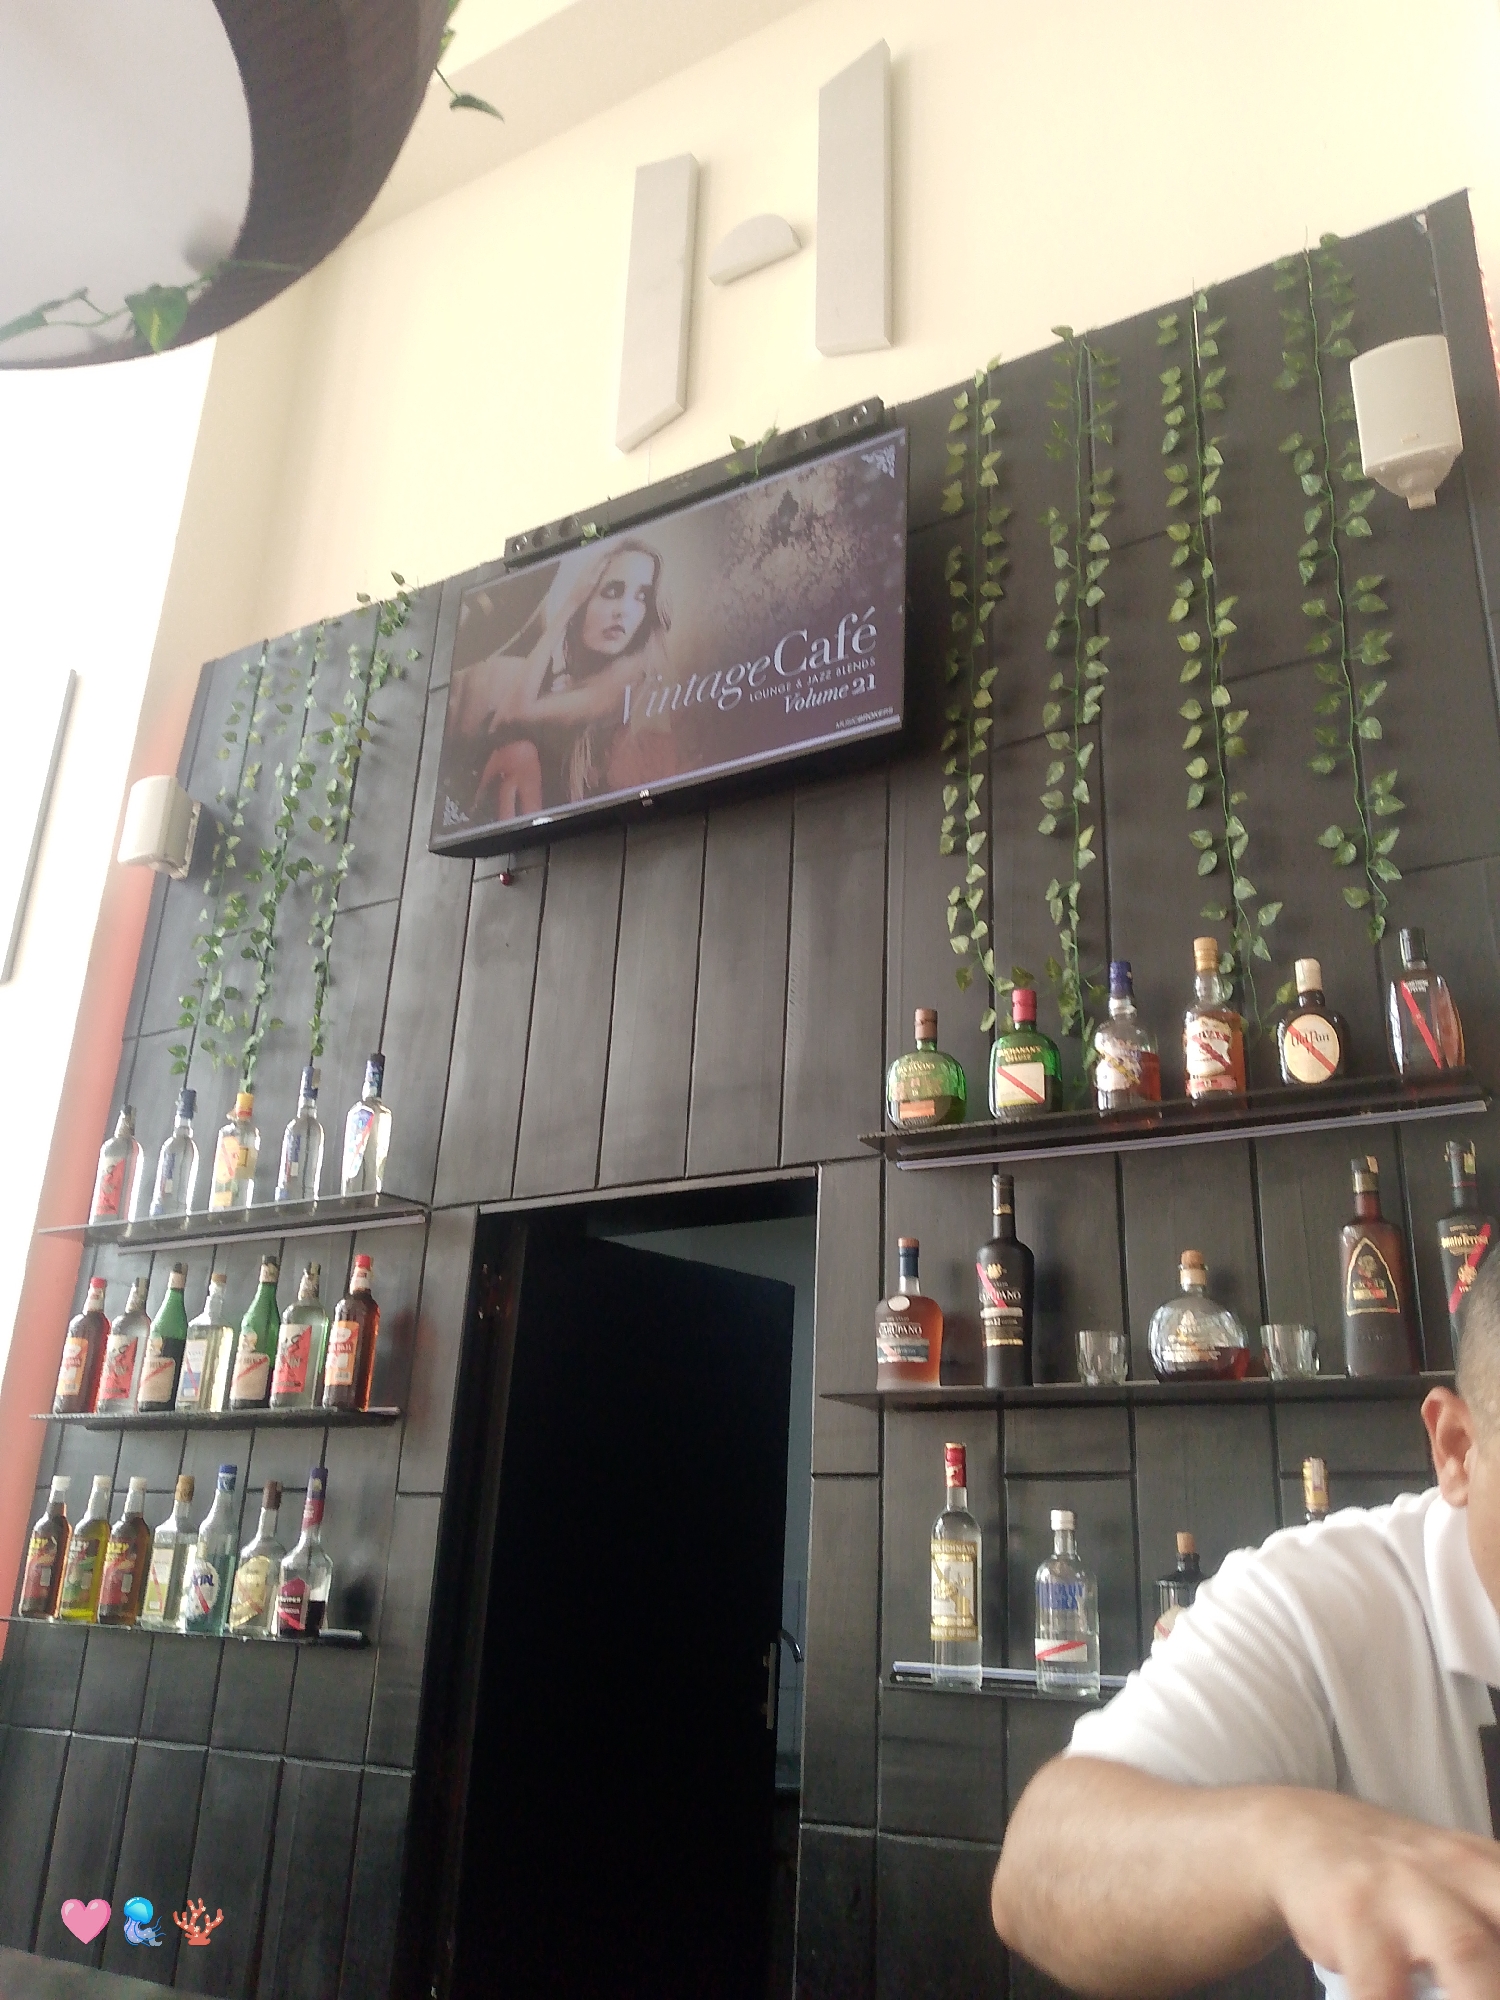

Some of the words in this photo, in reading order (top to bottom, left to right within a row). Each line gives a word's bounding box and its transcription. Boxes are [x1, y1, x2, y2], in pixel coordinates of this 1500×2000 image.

[749, 680, 792, 703] LOUNGE
[807, 669, 832, 685] JAZZ
[835, 656, 876, 677] BLENDS
[783, 684, 850, 714] Volume
[851, 673, 877, 696] 21
